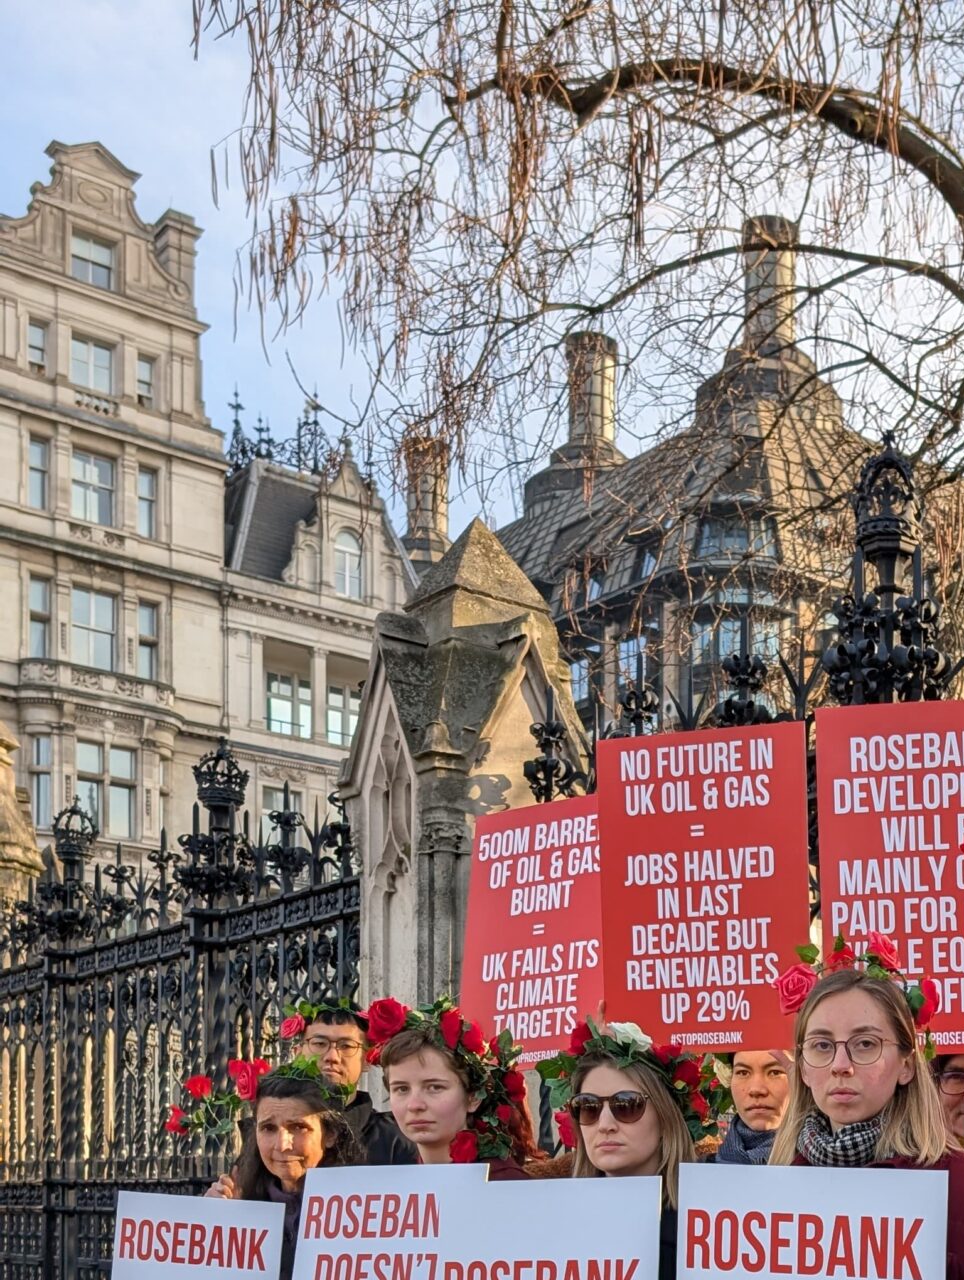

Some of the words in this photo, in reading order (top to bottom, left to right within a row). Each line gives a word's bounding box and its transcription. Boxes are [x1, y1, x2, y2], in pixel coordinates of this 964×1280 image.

[620, 749, 650, 782] NO
[657, 740, 743, 779] FUTURE
[750, 737, 774, 771] IN
[625, 783, 655, 817] UK
[661, 780, 697, 813] OIL
[703, 778, 718, 810] &
[724, 774, 770, 808] GAS
[478, 826, 530, 862] 500M
[534, 814, 600, 851] BARRE
[880, 814, 949, 853] WILL
[490, 859, 513, 889] OF
[516, 853, 545, 884] OIL
[550, 851, 563, 879] &
[624, 852, 678, 887] JOBS
[684, 845, 775, 883] HALVED
[838, 855, 947, 896] MAINLY
[510, 880, 574, 916] BURNT
[656, 887, 680, 919] IN
[686, 883, 743, 917] LAST
[831, 898, 895, 937] PAID
[904, 896, 957, 934] FOR
[632, 920, 720, 957] DECADE
[726, 917, 772, 950] BUT
[482, 951, 506, 982] UK
[511, 943, 563, 978] FAILS
[568, 939, 599, 970] ITS
[626, 952, 779, 991] RENEWABLES
[496, 973, 579, 1011] CLIMATE
[660, 992, 691, 1025] UP
[696, 990, 750, 1023] 29%
[493, 1006, 577, 1041] TARGETS
[671, 1031, 743, 1046] #STOPROSEBANK
[303, 1193, 440, 1240] ROSEBAN
[119, 1218, 269, 1272] ROSEBANK
